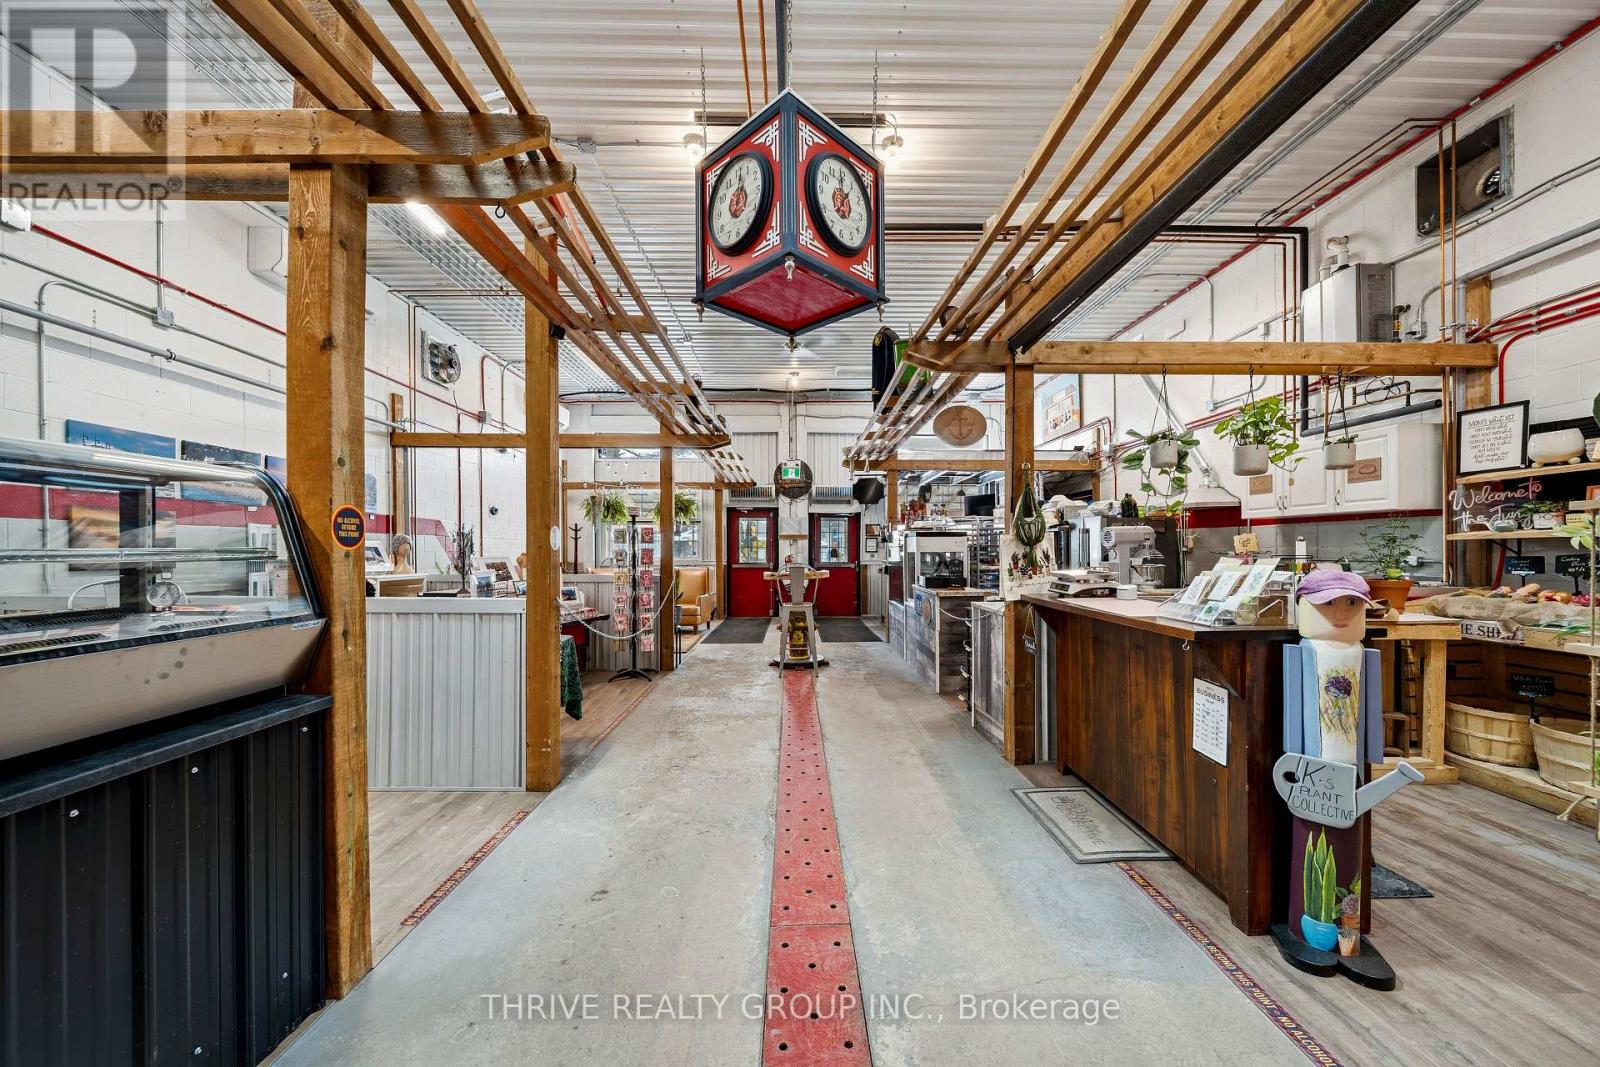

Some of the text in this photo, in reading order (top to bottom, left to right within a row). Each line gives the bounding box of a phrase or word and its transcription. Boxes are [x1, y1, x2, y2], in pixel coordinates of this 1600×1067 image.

[1449, 486, 1528, 510] Welcome
[1453, 511, 1488, 532] the
[1300, 786, 1344, 804] PLANT
[1292, 795, 1354, 820] COLLECTIVE
[1207, 944, 1237, 970] BEYOND
[1232, 970, 1254, 986] THIS
[1250, 988, 1278, 1010] POINT
[1278, 1016, 1296, 1028] NO
[1292, 1029, 1338, 1067] ALCOHOL
